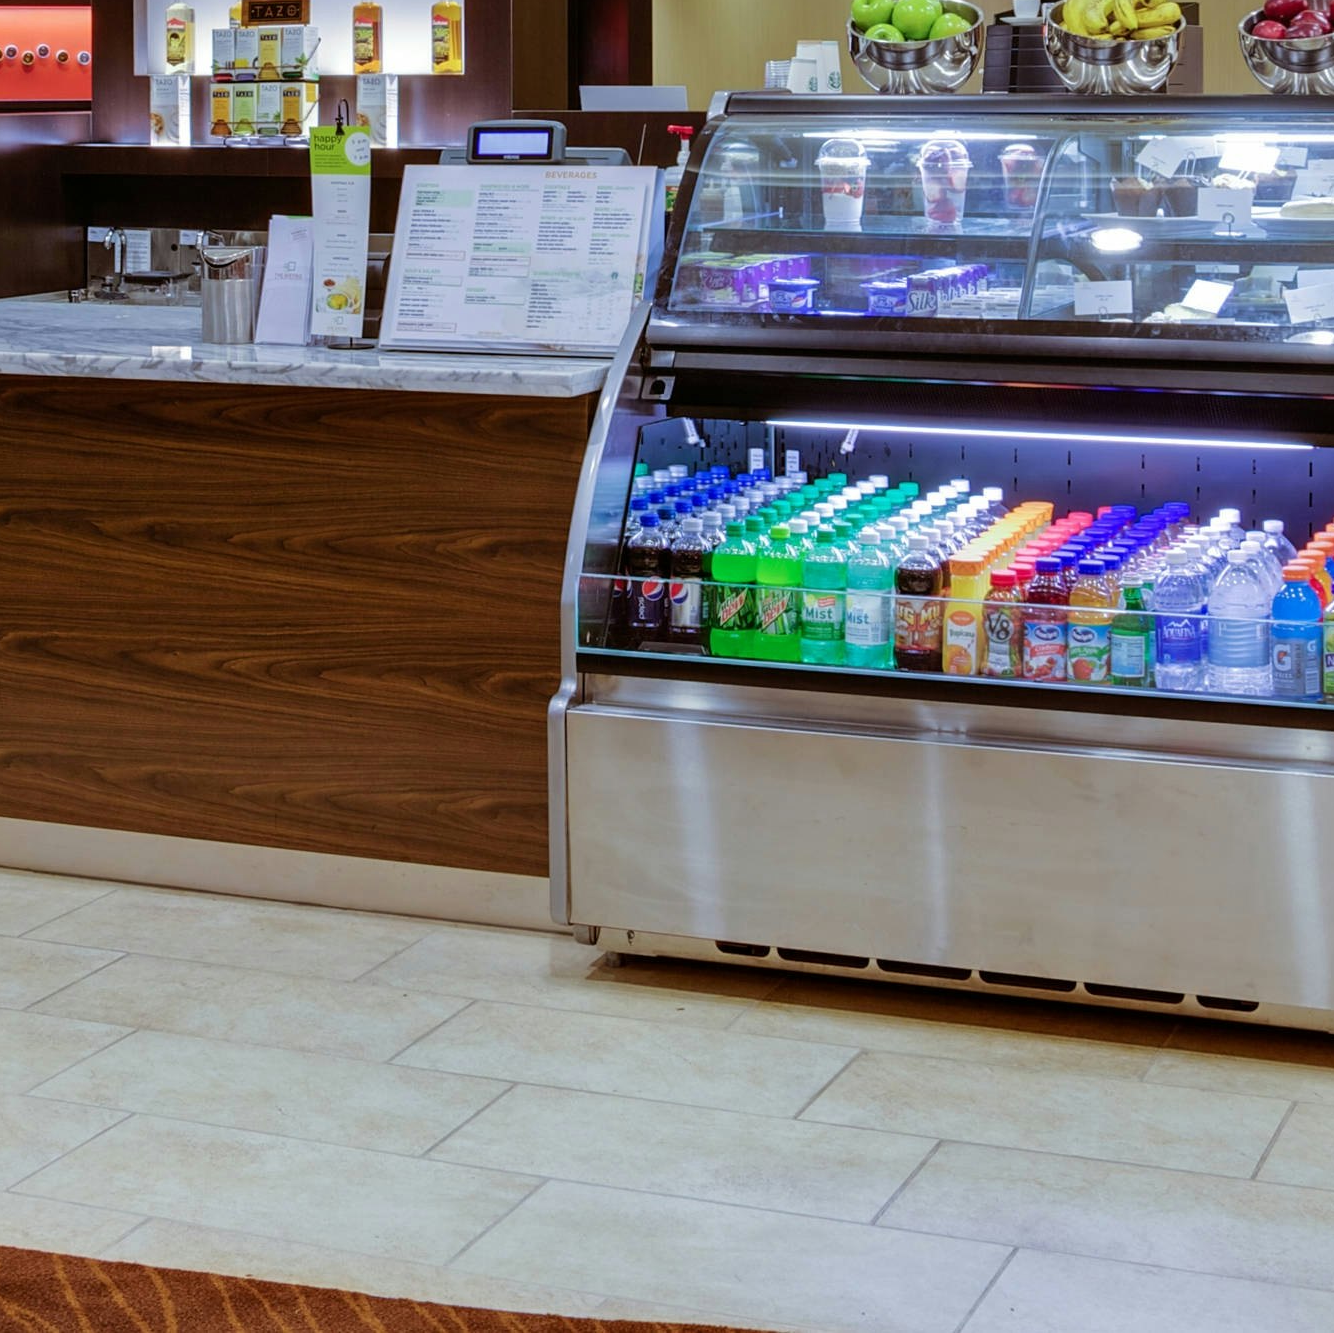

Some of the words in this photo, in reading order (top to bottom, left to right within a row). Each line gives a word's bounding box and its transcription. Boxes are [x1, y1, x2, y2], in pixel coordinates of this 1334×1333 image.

[254, 5, 298, 17] TAZO
[155, 78, 173, 86] TAZO
[313, 135, 342, 144] happy
[314, 143, 334, 151] hour
[545, 170, 597, 179] BEVERAGES
[908, 291, 937, 313] Silk
[638, 596, 646, 620] pepsi
[805, 607, 833, 620] Mist
[987, 610, 1010, 641] V8
[949, 629, 975, 638] Tropicana
[1163, 626, 1196, 639] AQUAFINA
[1273, 644, 1292, 672] G
